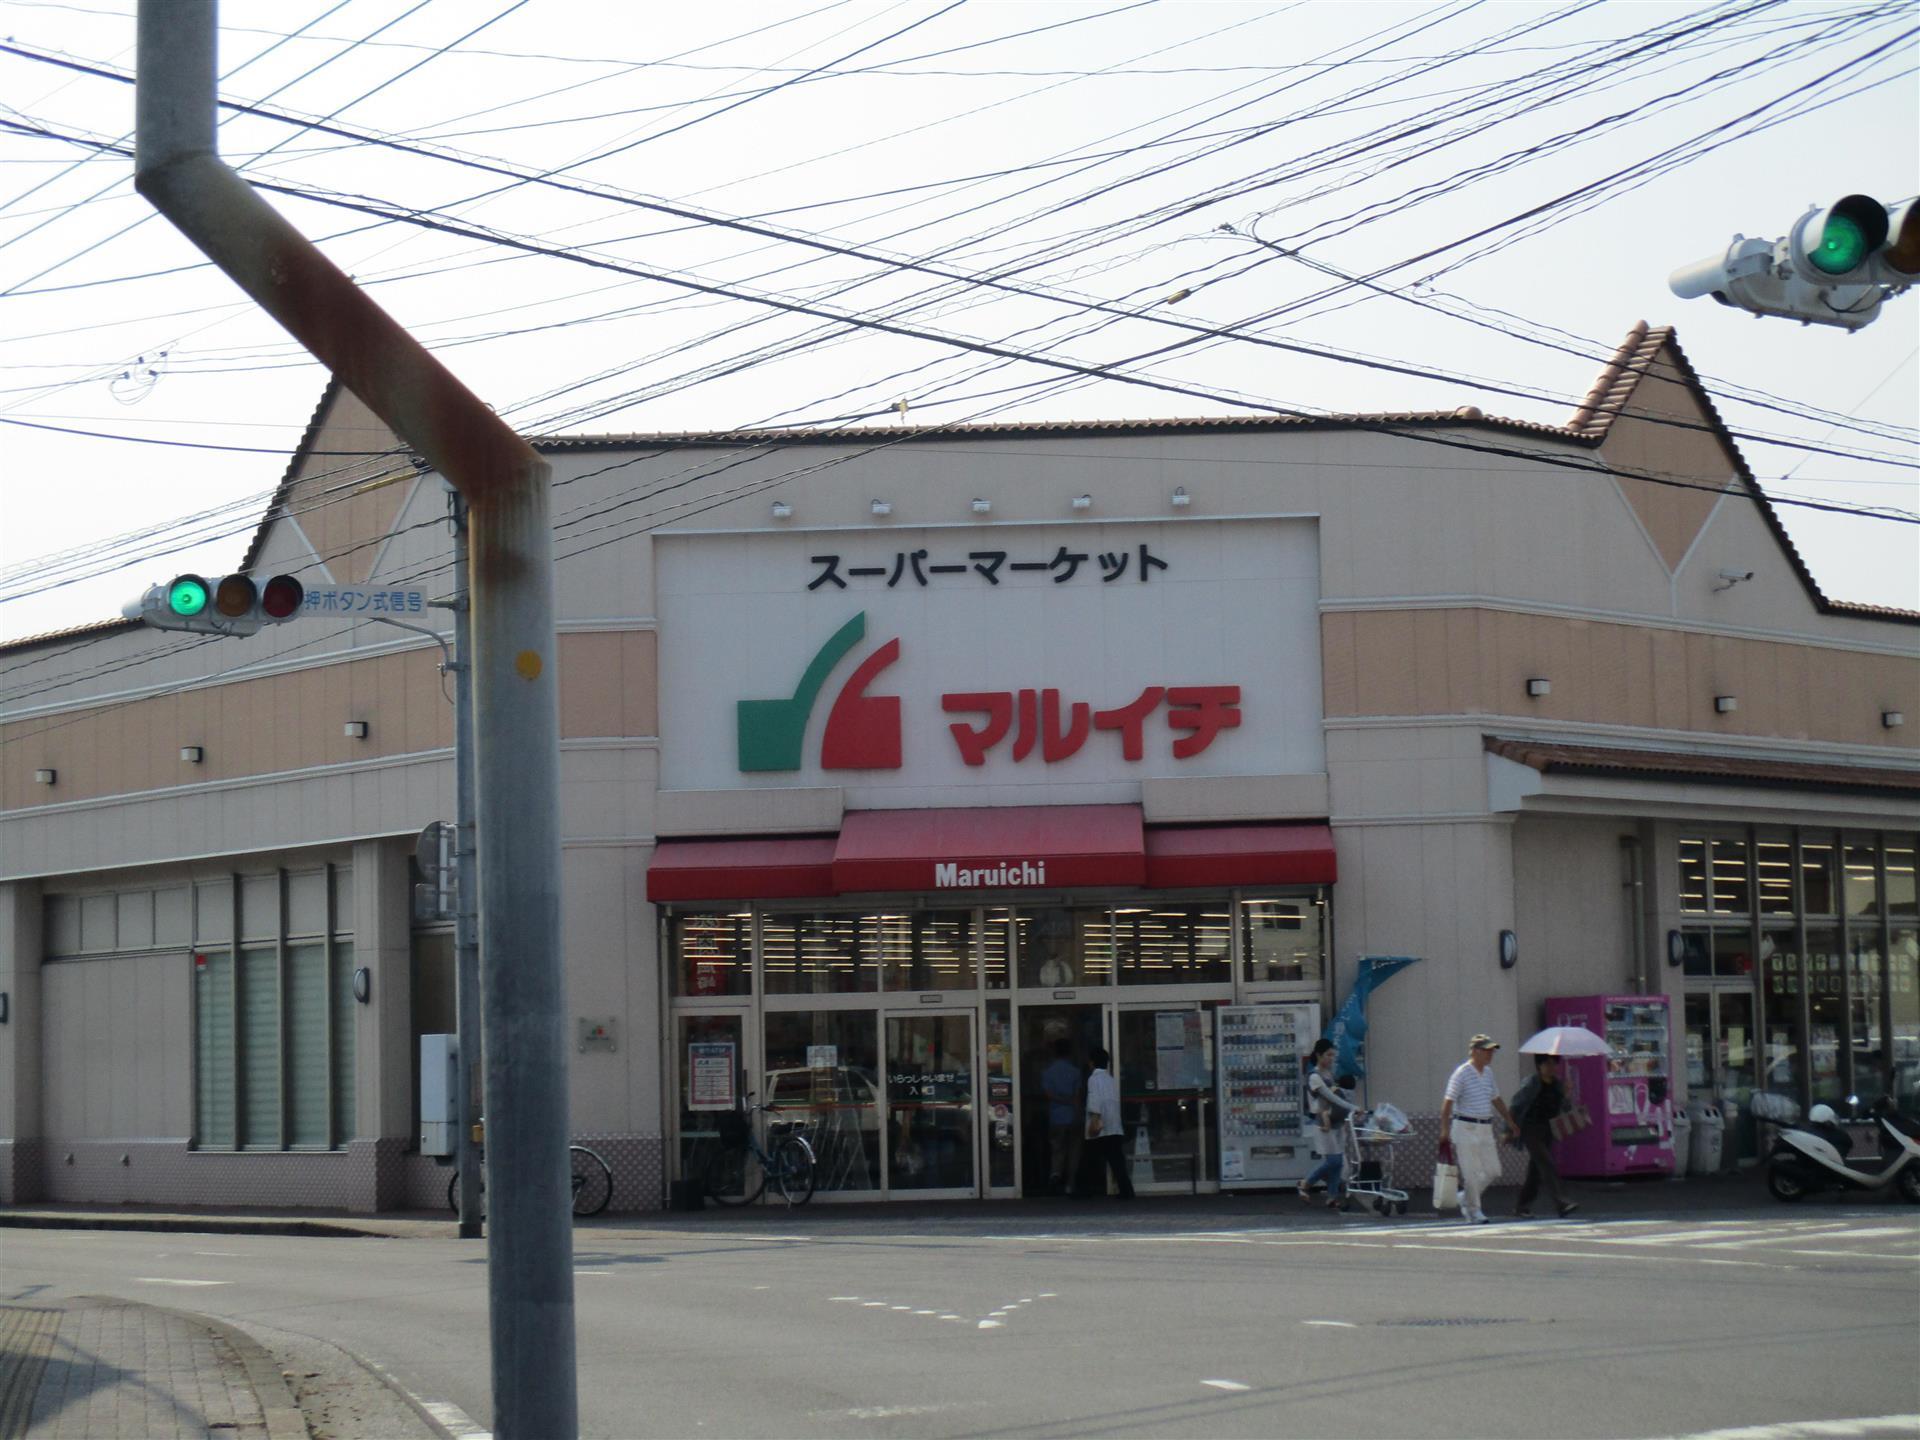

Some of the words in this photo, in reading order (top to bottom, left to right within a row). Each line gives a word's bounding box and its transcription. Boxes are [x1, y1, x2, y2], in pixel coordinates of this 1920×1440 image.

[807, 545, 1168, 591] スーパーマーケット
[304, 590, 422, 612] 押ボタン式信号
[941, 685, 1241, 766] マルイチ
[935, 861, 1046, 888] Maruichi
